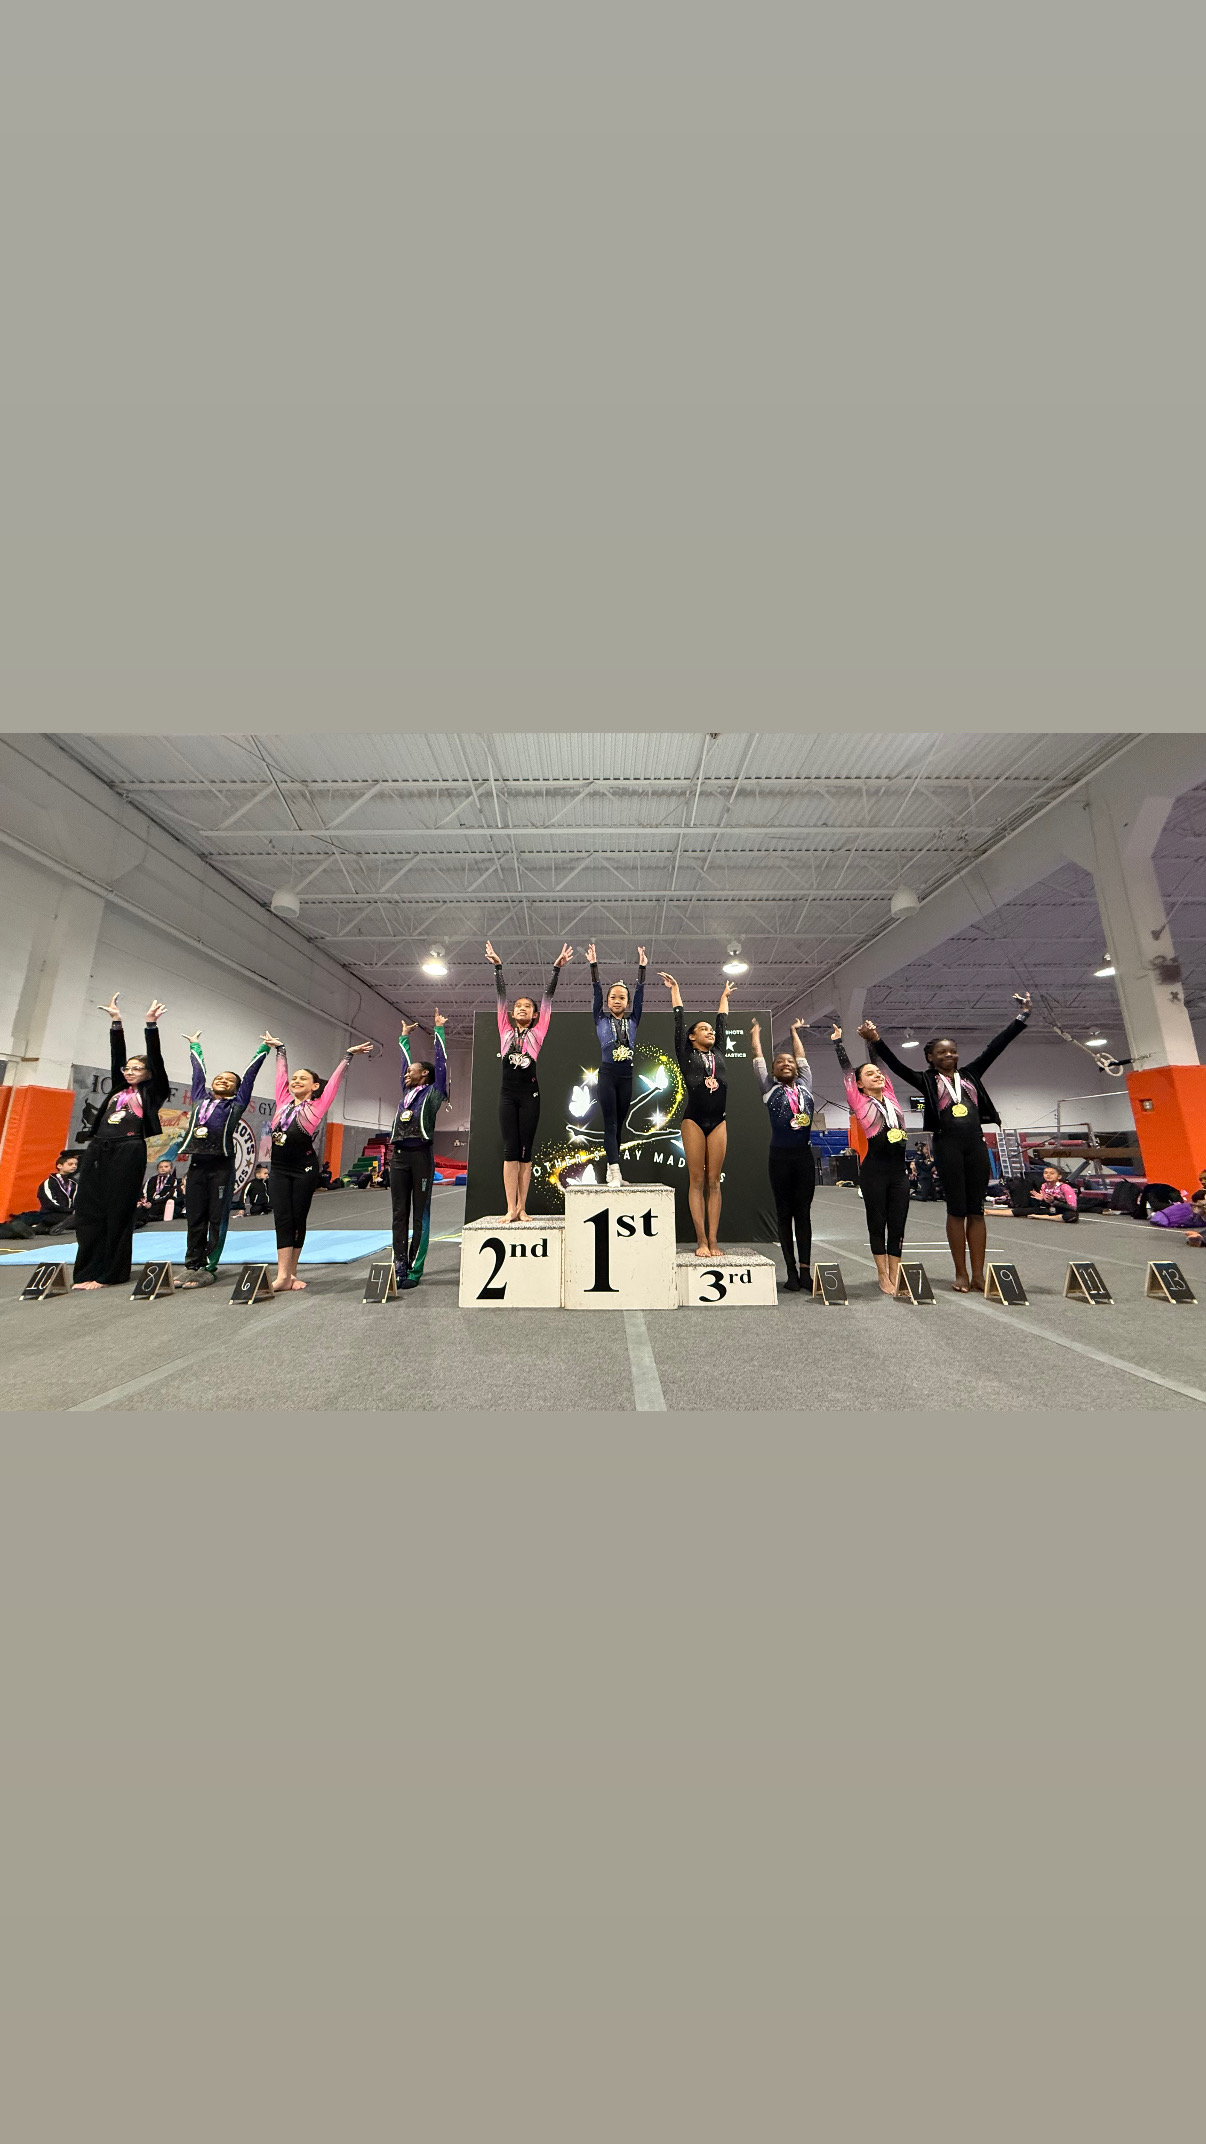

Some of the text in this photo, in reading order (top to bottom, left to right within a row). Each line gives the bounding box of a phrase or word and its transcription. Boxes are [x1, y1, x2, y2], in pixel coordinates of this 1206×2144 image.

[532, 1151, 600, 1177] OTHER'S
[623, 1149, 642, 1161] AY
[582, 1207, 659, 1293] 1st
[26, 1265, 57, 1290] 10
[142, 1265, 159, 1292] 8
[241, 1269, 252, 1292] 6
[476, 1236, 549, 1300] 2nd
[824, 1270, 838, 1291] 5
[1079, 1267, 1106, 1295] 11
[1162, 1268, 1187, 1291] 13
[370, 1269, 384, 1294] 4
[698, 1269, 753, 1303] 3rd
[908, 1269, 922, 1295] 7
[999, 1269, 1019, 1295] 9
